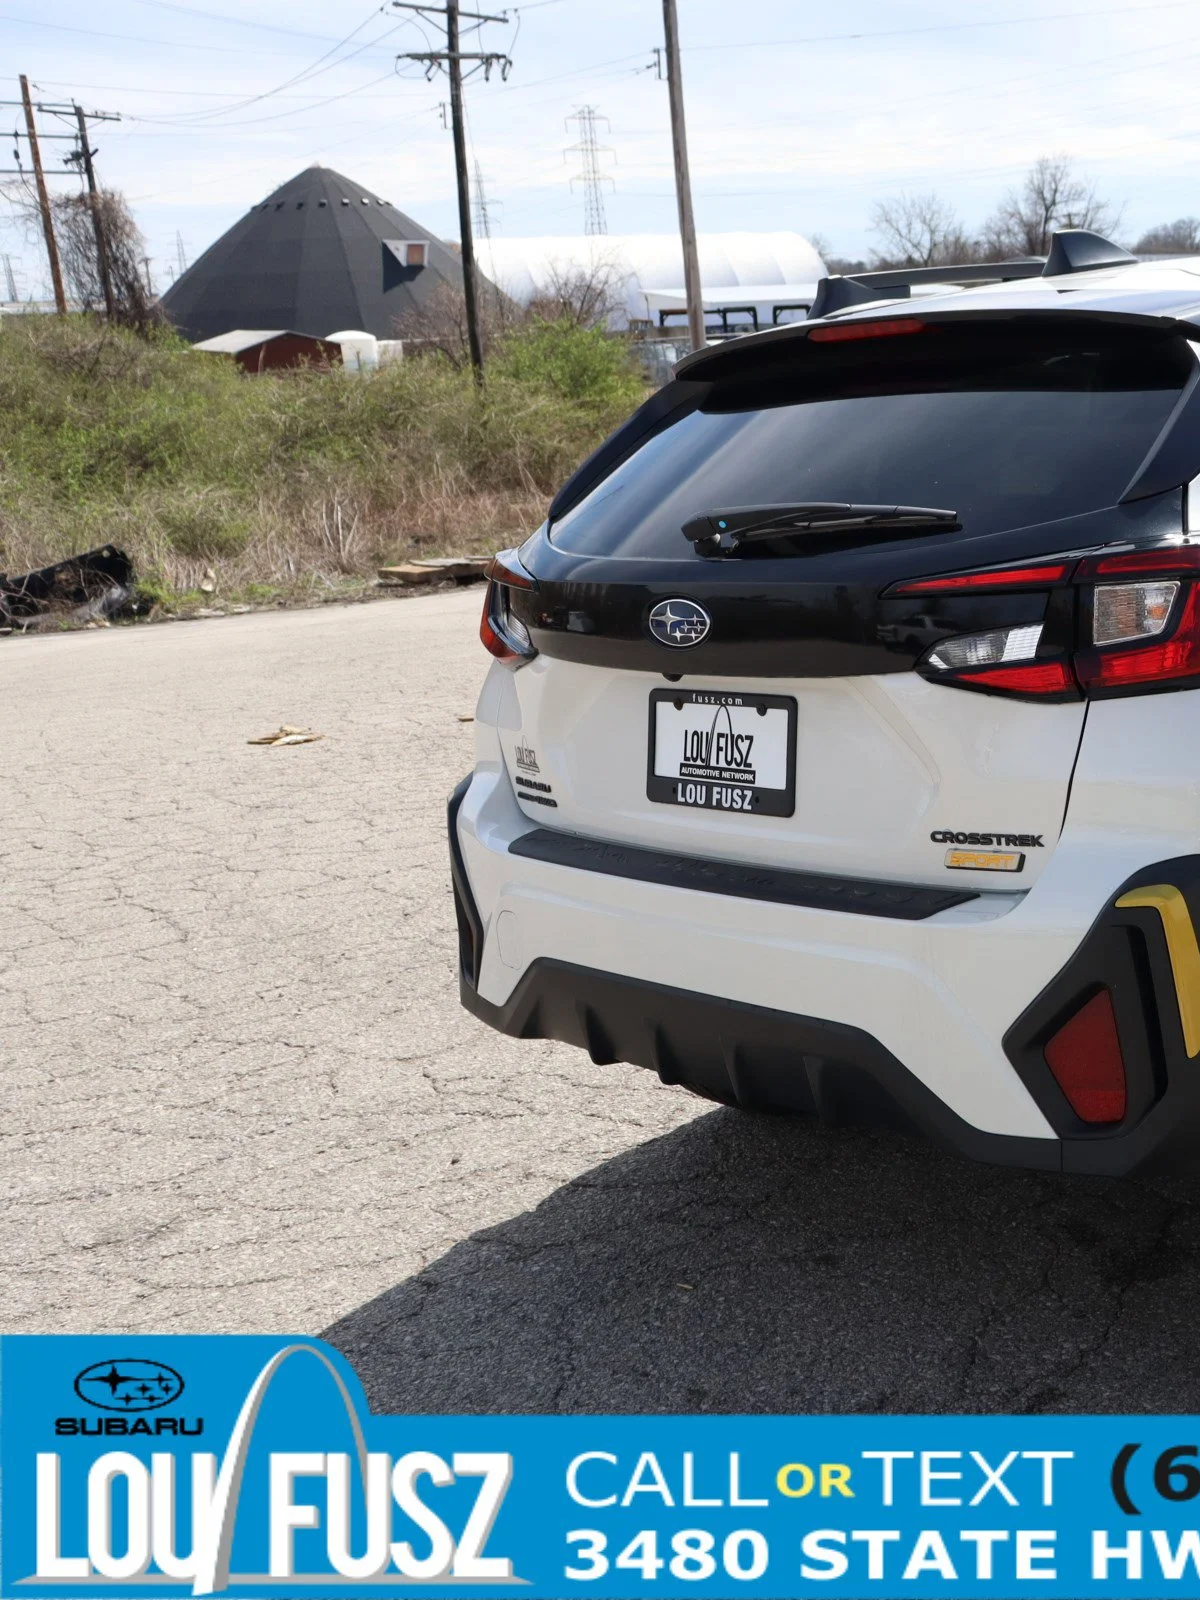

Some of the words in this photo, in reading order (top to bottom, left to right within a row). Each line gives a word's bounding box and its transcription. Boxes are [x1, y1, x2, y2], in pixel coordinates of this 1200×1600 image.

[692, 693, 743, 705] fusz.com
[683, 729, 710, 763] LOU
[716, 732, 754, 768] FUSZ
[681, 766, 720, 778] AUTOMOTIVE
[721, 770, 754, 782] NETWORK
[677, 783, 706, 804] LOU
[712, 786, 753, 810] FUSZ
[930, 831, 1045, 847] CROSSTREK
[950, 852, 1015, 868] SPORT
